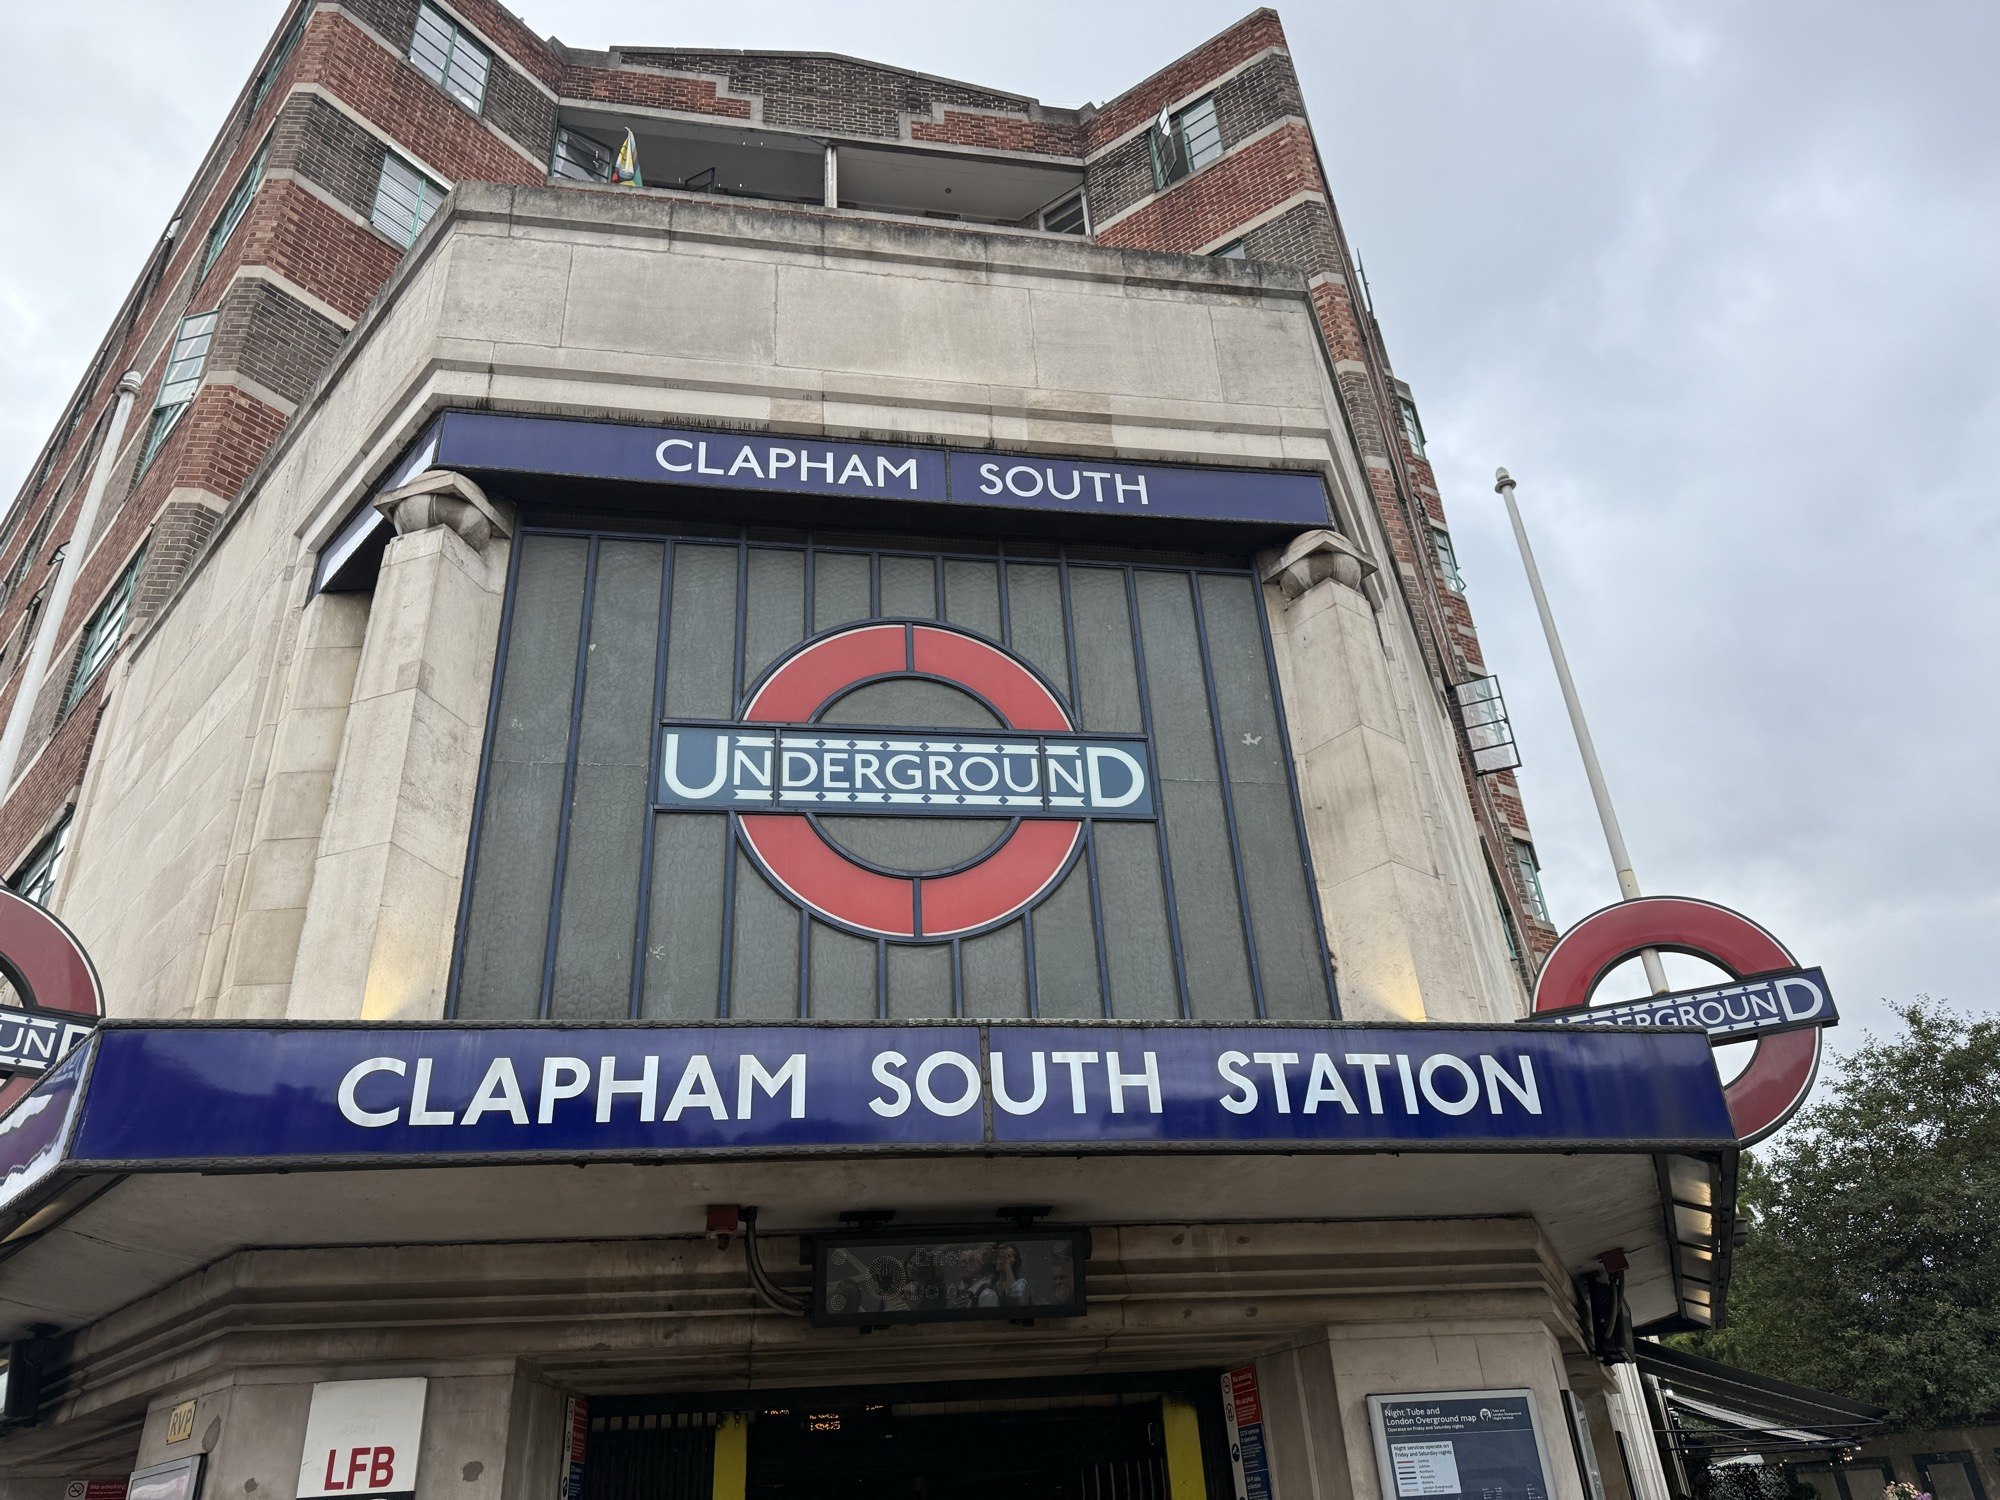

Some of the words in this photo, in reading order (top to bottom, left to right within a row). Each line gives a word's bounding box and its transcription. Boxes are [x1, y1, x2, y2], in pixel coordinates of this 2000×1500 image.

[655, 439, 918, 490] CLAPHAM
[978, 462, 1150, 505] SOUTH
[664, 733, 1146, 808] UNDERGROUND
[337, 1053, 807, 1128] CLAPHAM
[868, 1050, 1163, 1118] SOUTH
[1217, 1050, 1544, 1117] STATION
[171, 1407, 193, 1437] RVP
[1384, 1408, 1406, 1418] Night
[1406, 1408, 1424, 1416] Tube
[1386, 1418, 1414, 1426] London
[1416, 1416, 1459, 1425] Overground
[1461, 1415, 1477, 1423] map
[324, 1446, 396, 1491] LFB
